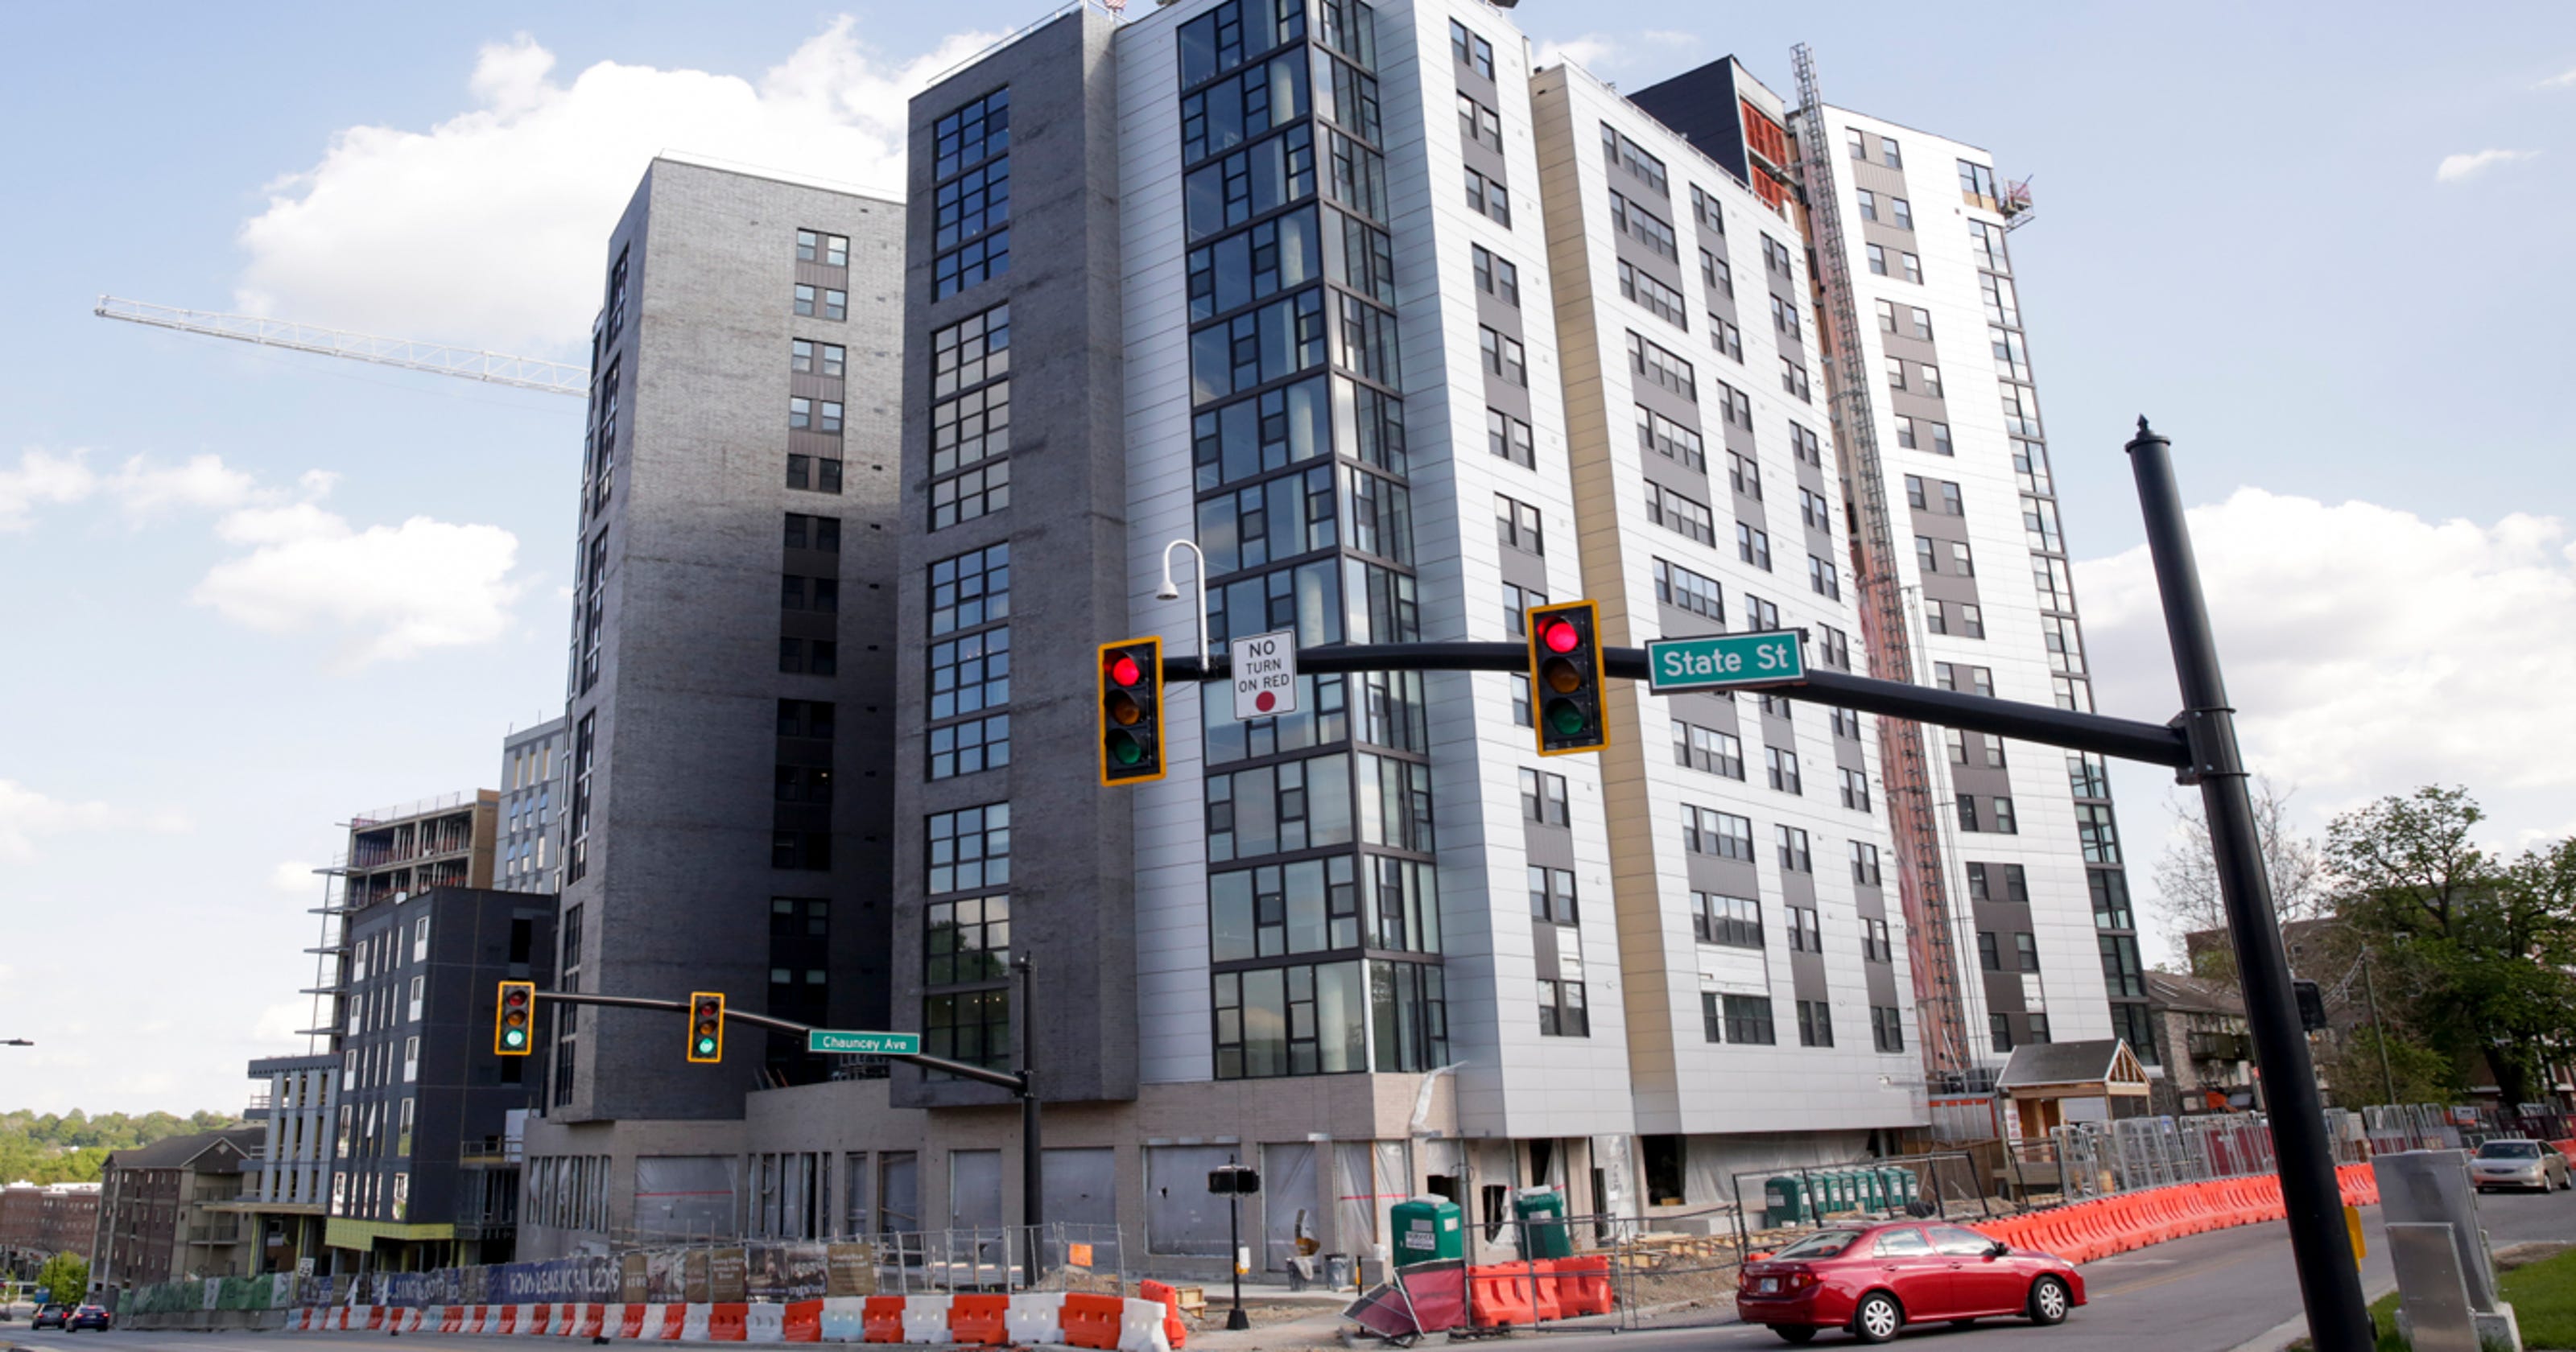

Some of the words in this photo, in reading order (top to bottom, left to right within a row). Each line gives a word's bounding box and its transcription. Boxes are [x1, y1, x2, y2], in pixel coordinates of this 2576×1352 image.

[1249, 640, 1275, 658] NO
[1246, 658, 1281, 674] TURN
[1664, 648, 1742, 677] State
[1757, 643, 1789, 670] St
[1238, 678, 1257, 693] ON
[1263, 674, 1290, 689] RED
[823, 1036, 880, 1053] Chauncey
[885, 1037, 906, 1050] Ave
